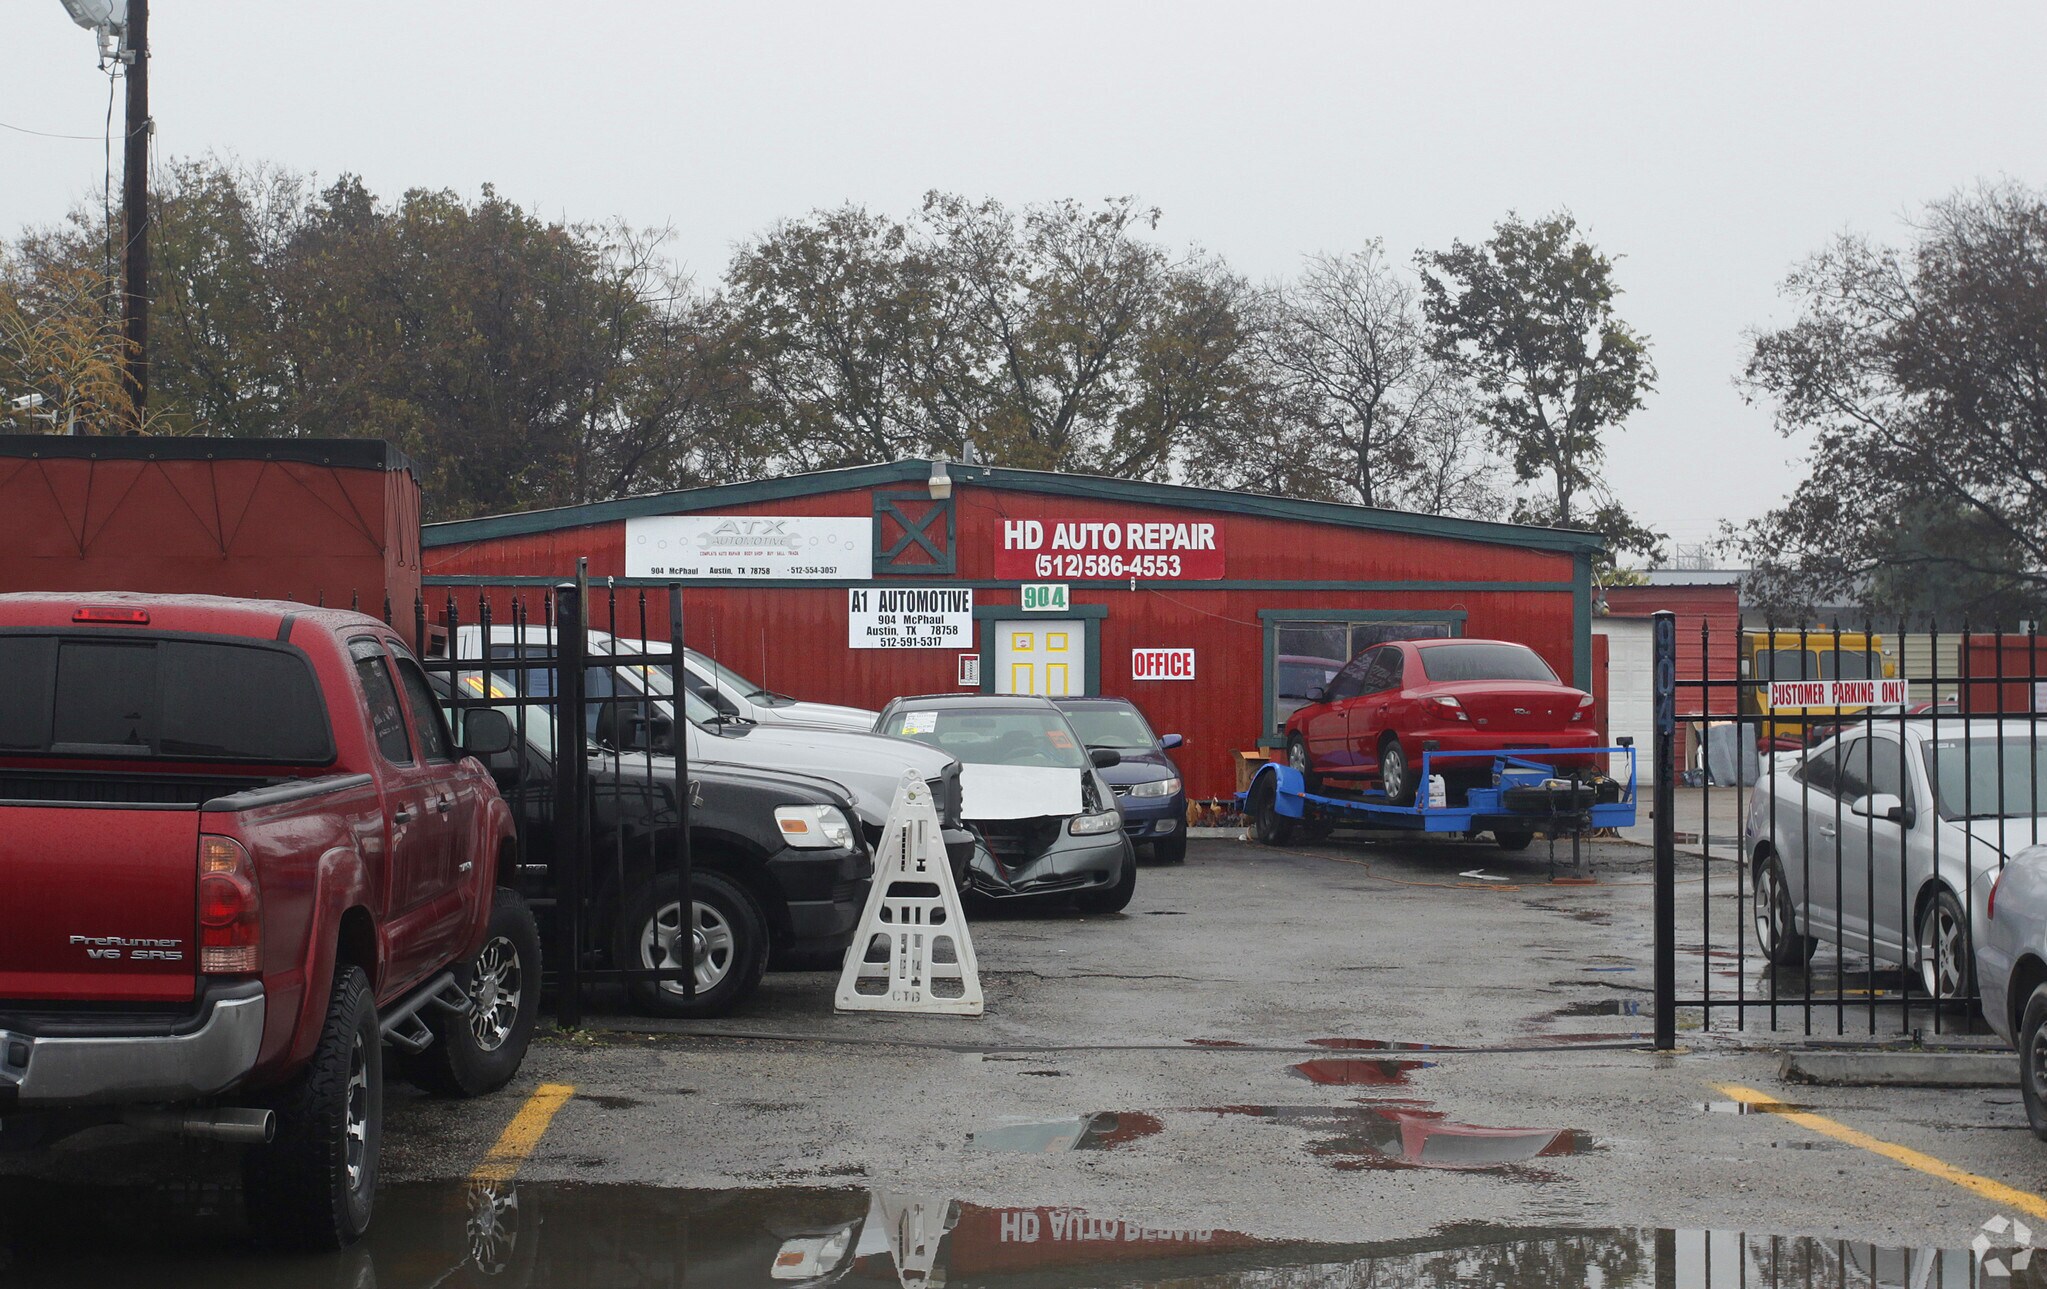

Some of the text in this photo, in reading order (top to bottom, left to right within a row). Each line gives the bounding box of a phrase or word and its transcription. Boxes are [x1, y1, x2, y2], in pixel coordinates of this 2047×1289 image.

[711, 519, 788, 535] ATX
[711, 536, 787, 546] AUTOMOTIVE
[1004, 520, 1216, 550] HD AUTO REPAIR
[650, 567, 664, 575] 904
[668, 567, 699, 575] McPhaul
[737, 567, 746, 575] TX
[750, 567, 771, 575] 78758
[1035, 553, 1181, 577] (512)586-4553
[851, 590, 970, 613] A1 AUTOMOTIVE
[1023, 586, 1066, 609] 904
[878, 614, 944, 625] 904 McPhaul
[866, 625, 958, 636] Austin, TX 78758
[880, 636, 942, 648] 512-591-5317
[1133, 652, 1192, 677] OFFICE
[1772, 681, 1905, 705] CUSTOMER PARKING ONLY
[69, 935, 183, 947] PreRunner
[86, 949, 183, 961] V6 SR5
